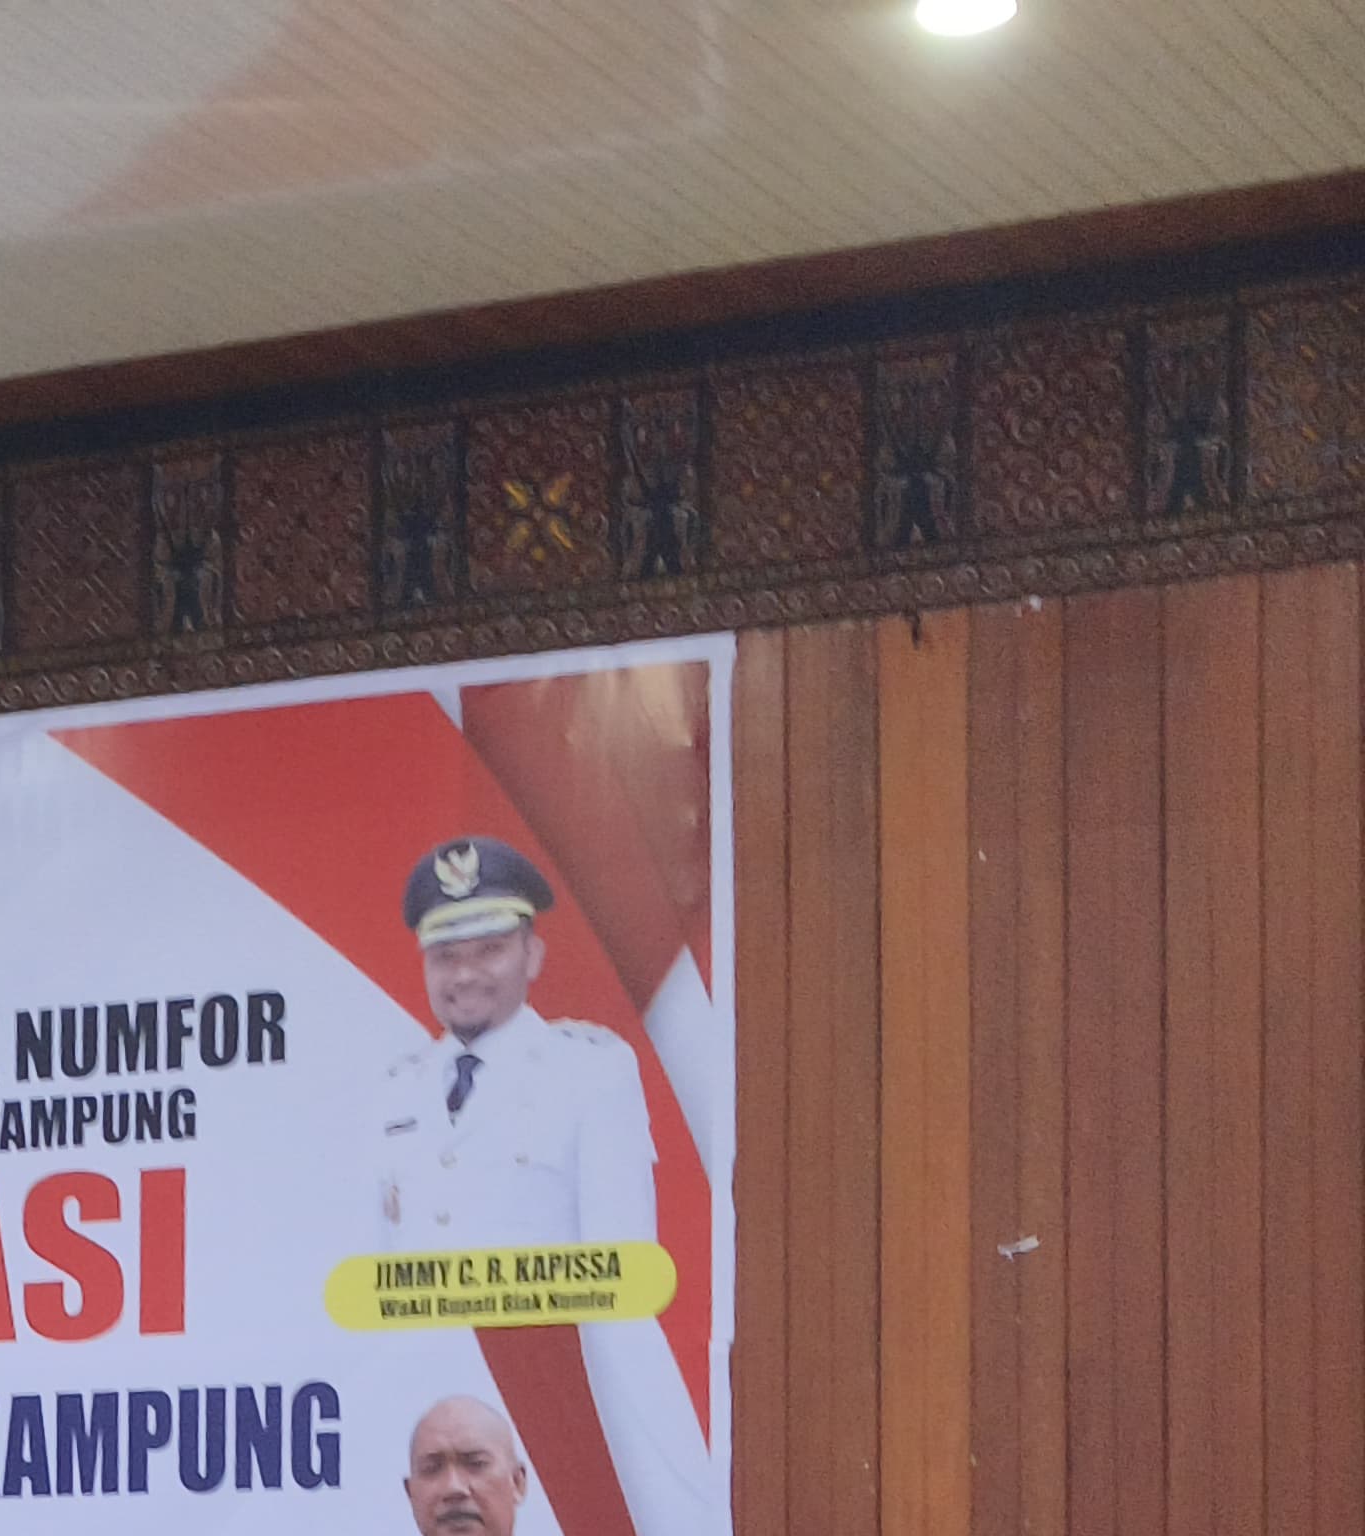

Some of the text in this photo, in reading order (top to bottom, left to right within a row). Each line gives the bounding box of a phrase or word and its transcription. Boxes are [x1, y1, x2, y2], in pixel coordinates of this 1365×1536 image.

[16, 992, 285, 1081] NUMFOR
[376, 1260, 450, 1289] JIMMY
[516, 1250, 621, 1283] KAPISSA
